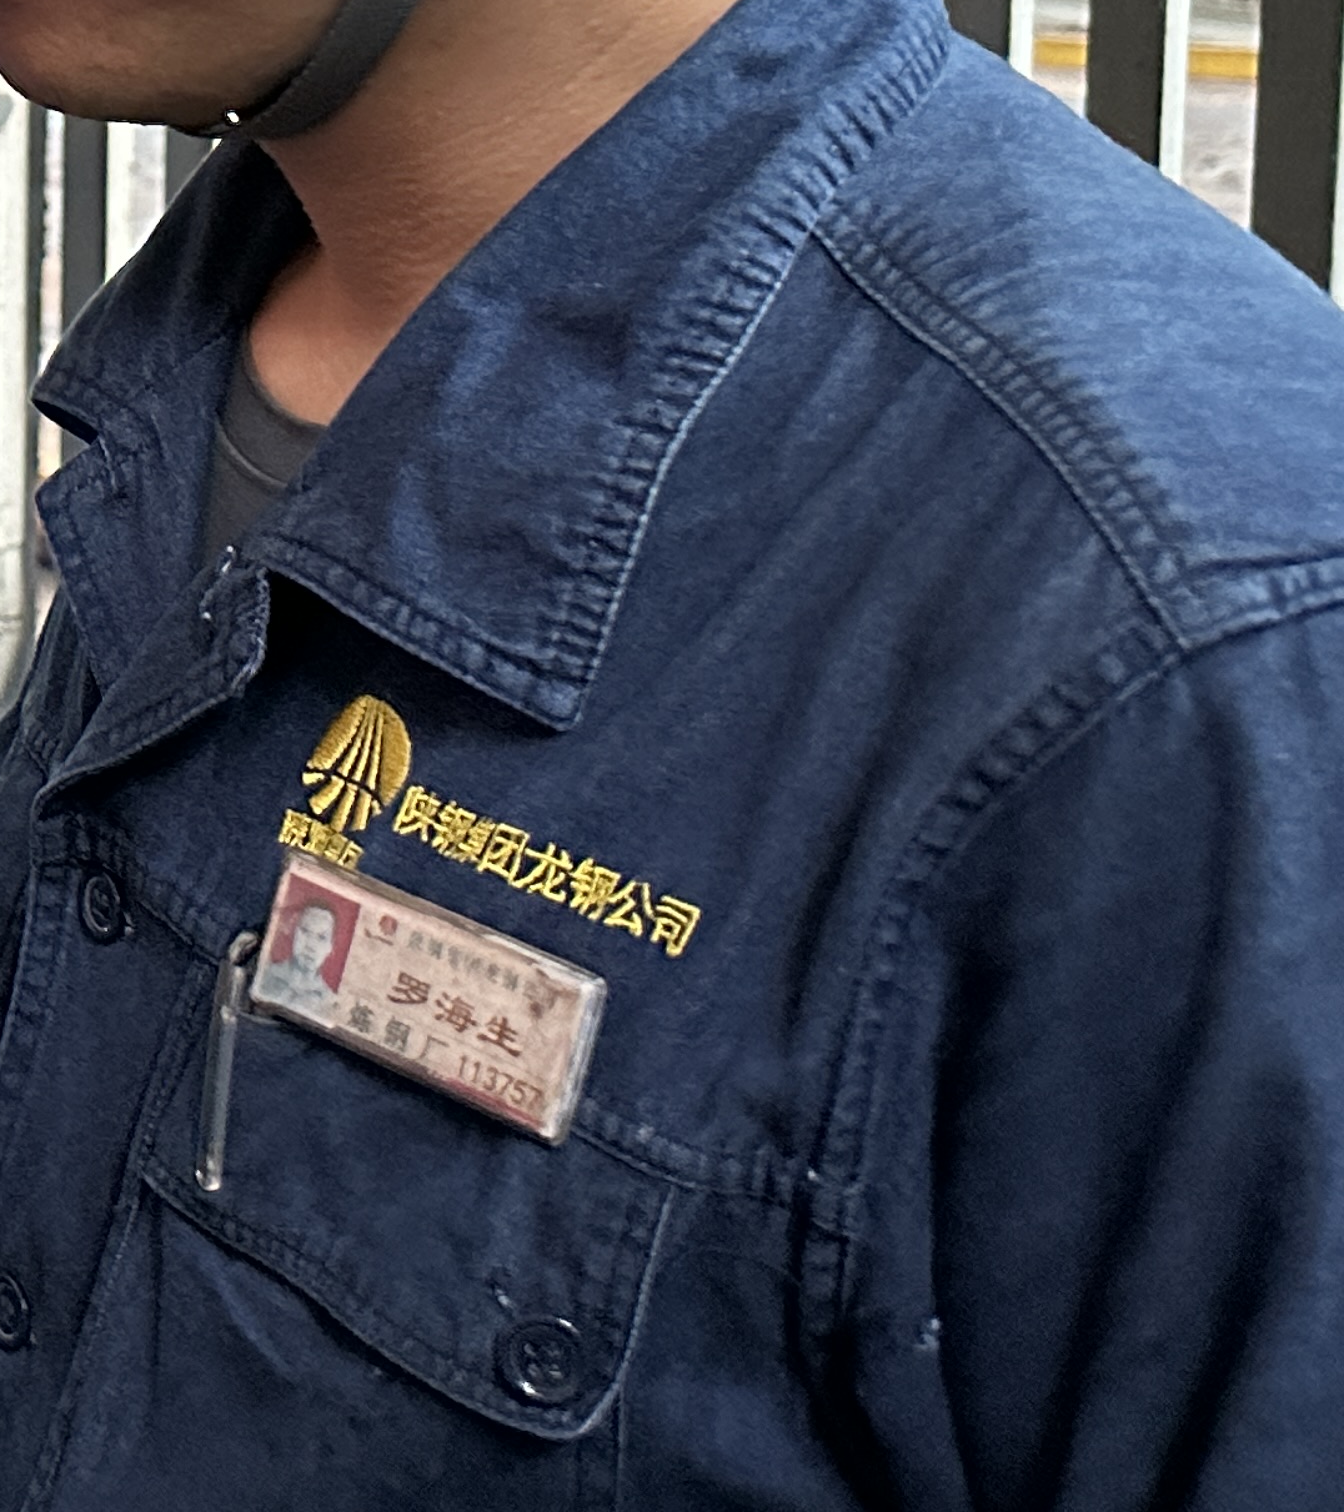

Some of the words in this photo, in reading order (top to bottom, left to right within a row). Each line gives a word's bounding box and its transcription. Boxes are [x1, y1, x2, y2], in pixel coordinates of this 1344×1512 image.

[392, 786, 701, 958] 陕钢集团龙钢公司
[387, 971, 522, 1057] 罗海生
